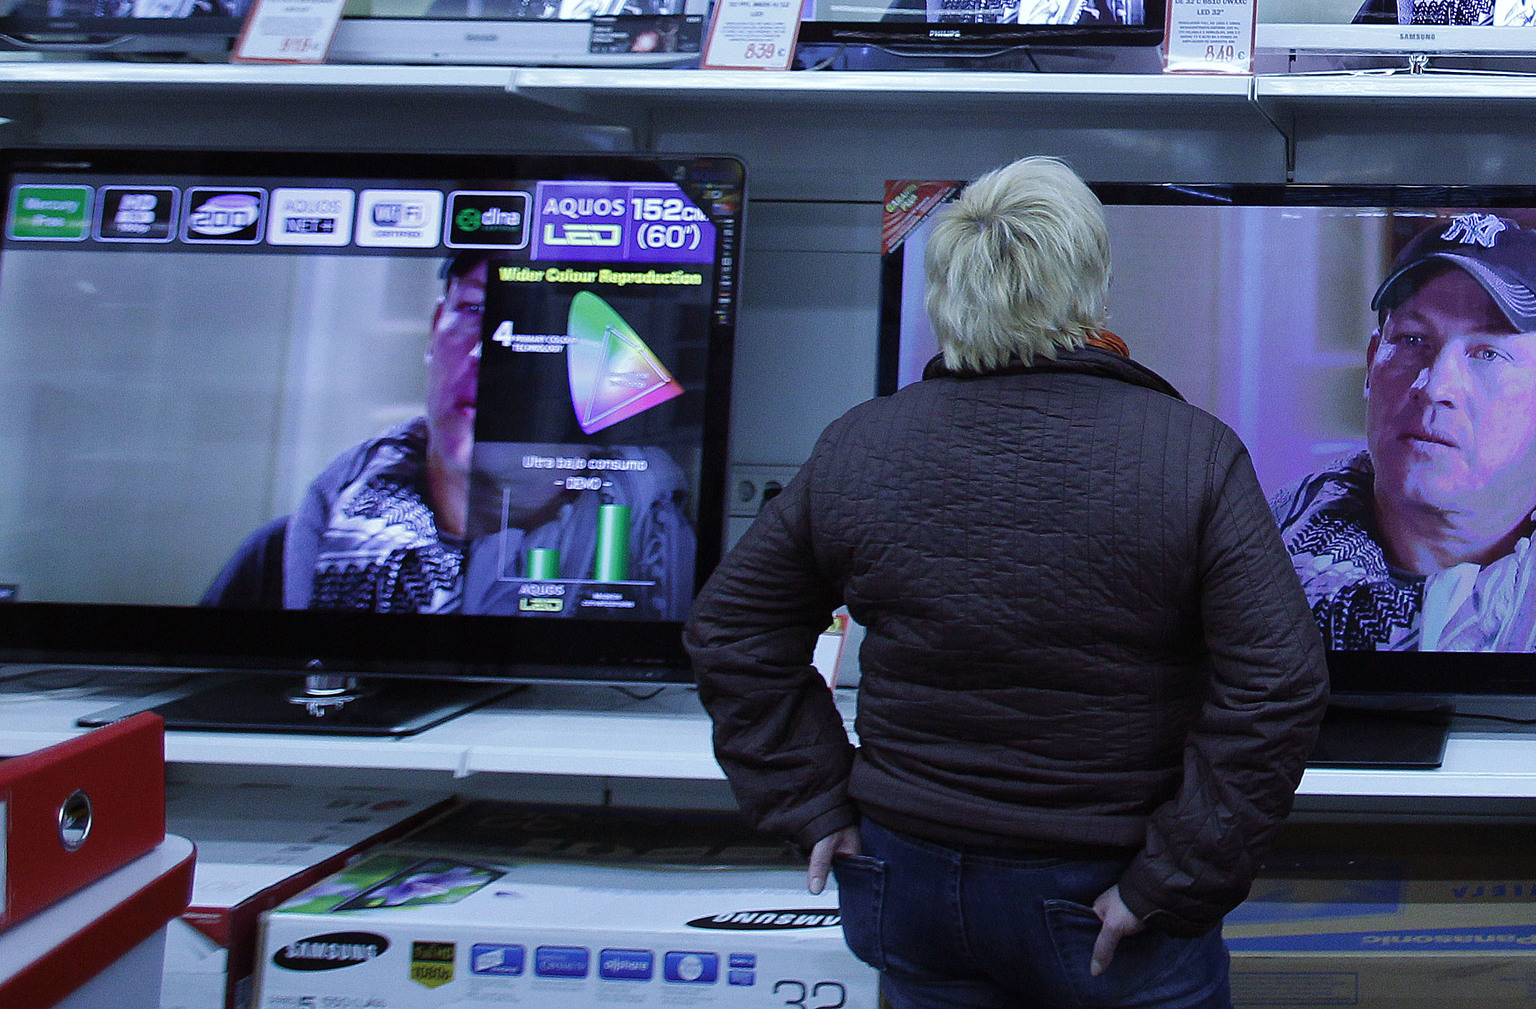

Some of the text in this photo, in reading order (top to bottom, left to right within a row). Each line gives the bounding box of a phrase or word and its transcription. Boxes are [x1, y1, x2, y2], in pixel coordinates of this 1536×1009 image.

[1204, 44, 1235, 63] 849
[541, 197, 626, 219] AQUOS
[543, 223, 623, 246] LED
[498, 267, 703, 286] Wider Colour Reproduction
[492, 320, 514, 347] 4
[521, 455, 649, 472] Ultra bajo consumo
[285, 941, 379, 962] SAMSUNG
